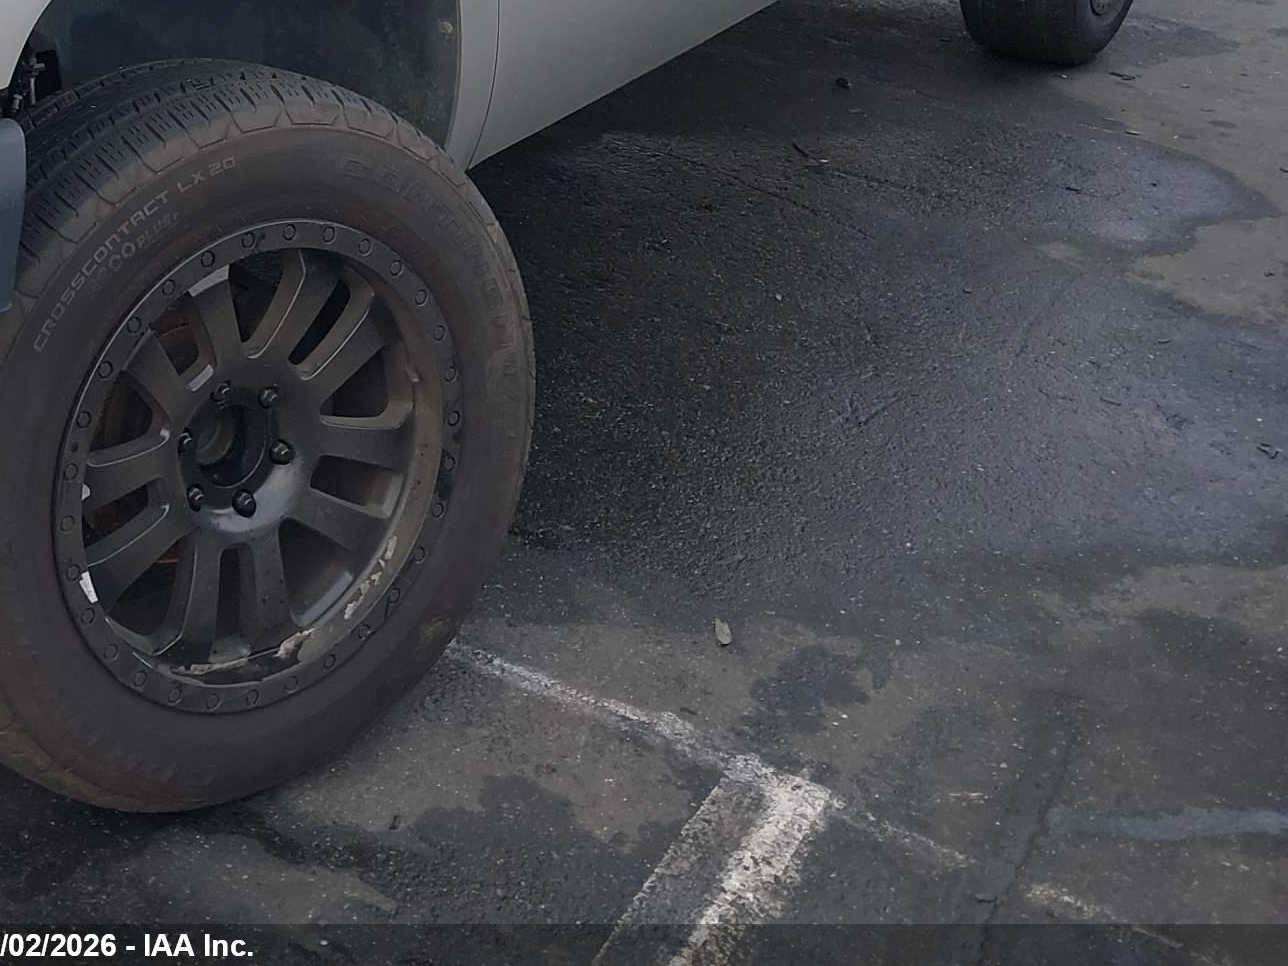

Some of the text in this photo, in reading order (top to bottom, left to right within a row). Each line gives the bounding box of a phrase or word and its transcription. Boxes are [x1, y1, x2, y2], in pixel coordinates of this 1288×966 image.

[33, 156, 237, 353] CROSSCONTACT LX 20
